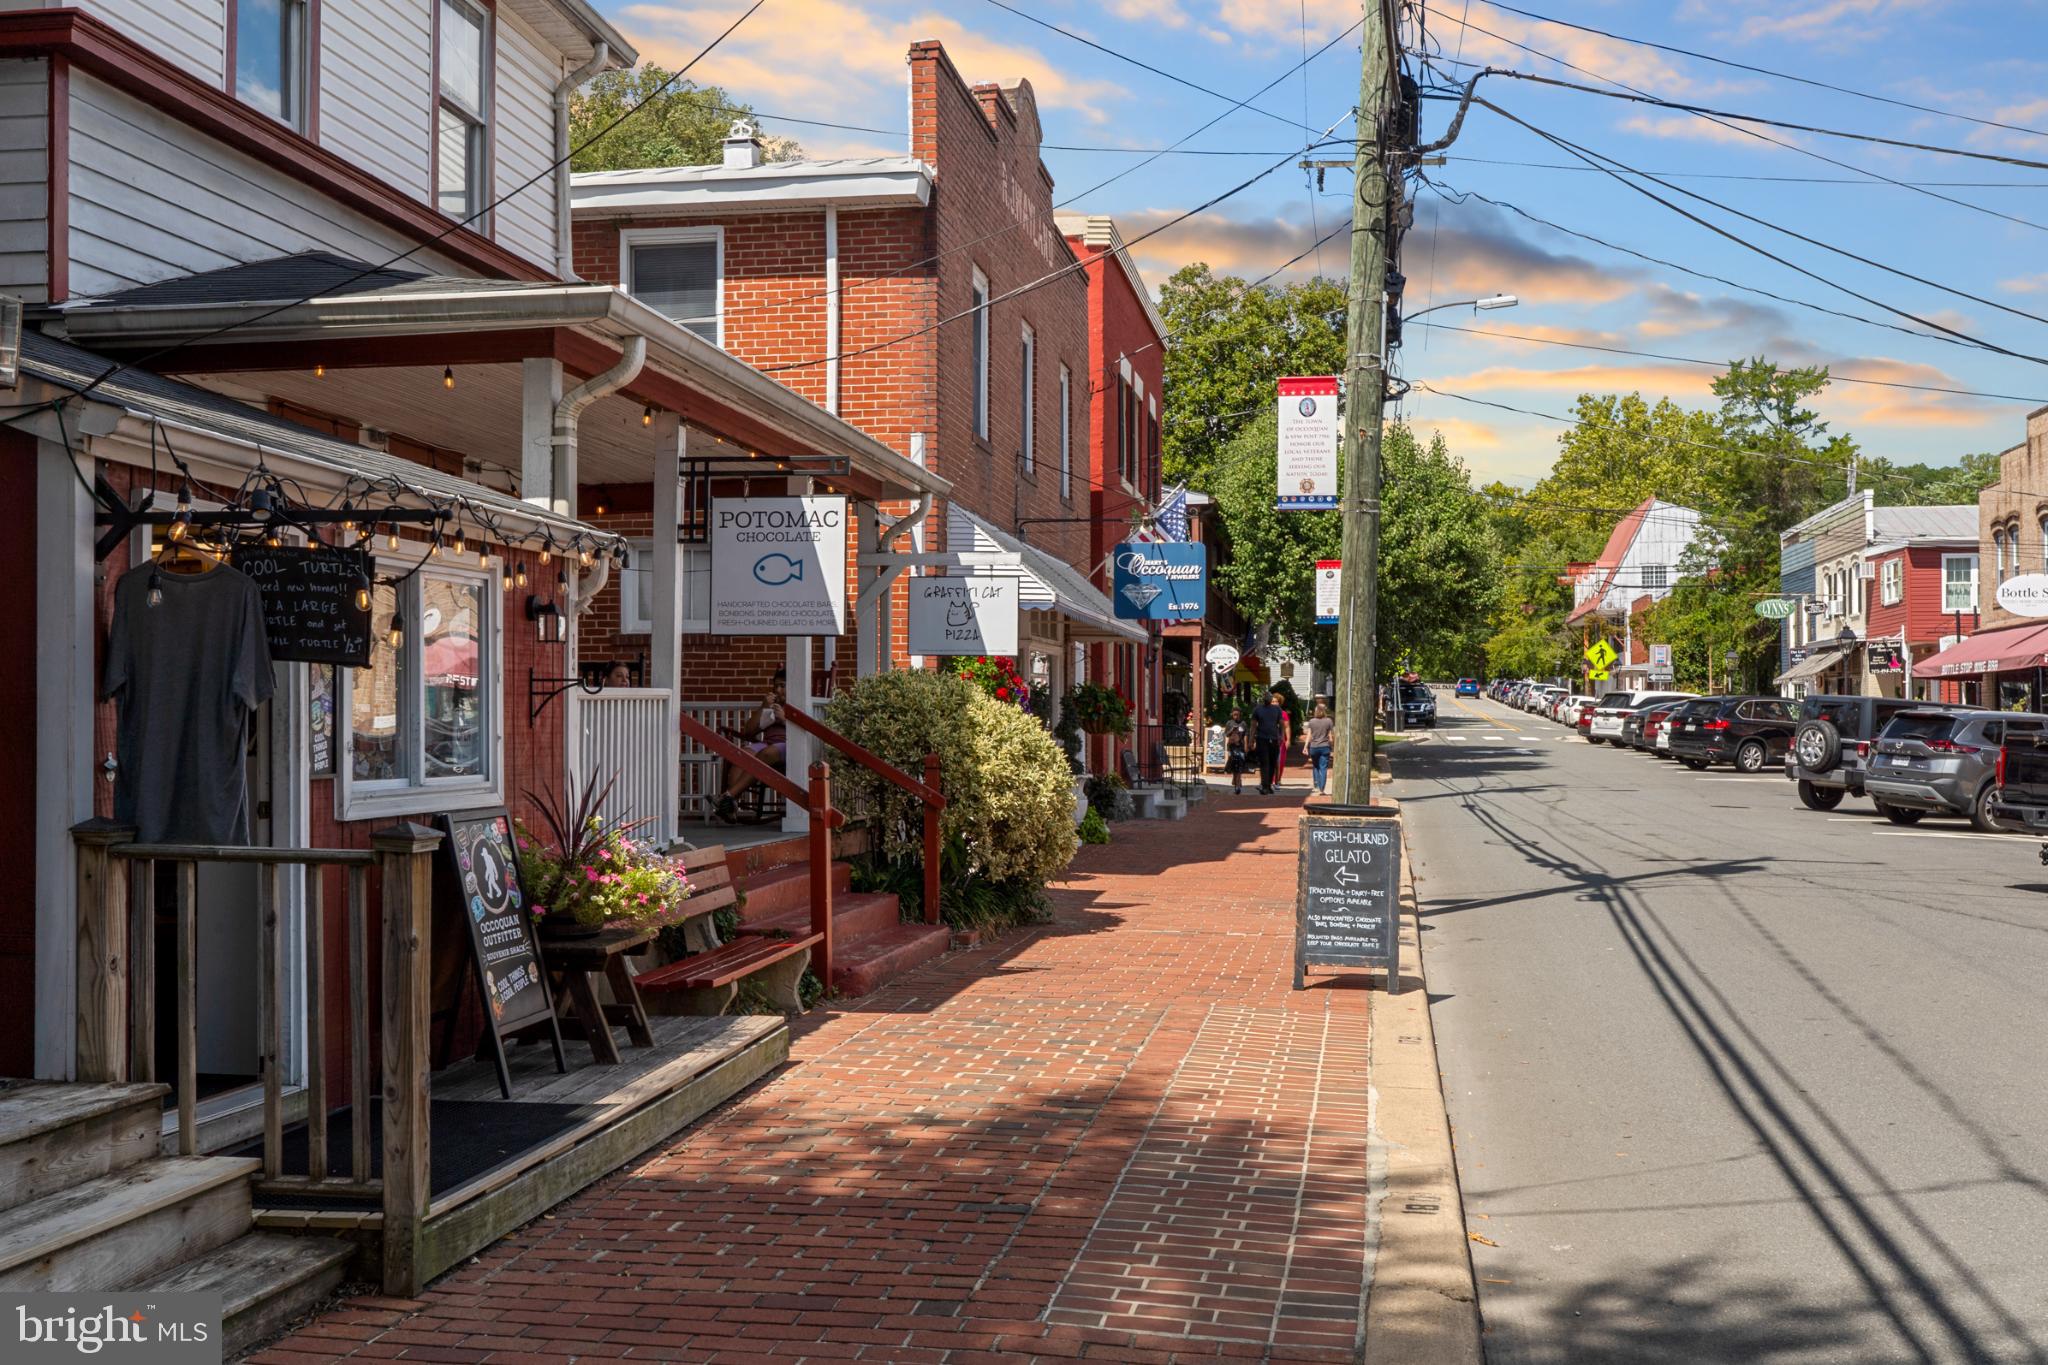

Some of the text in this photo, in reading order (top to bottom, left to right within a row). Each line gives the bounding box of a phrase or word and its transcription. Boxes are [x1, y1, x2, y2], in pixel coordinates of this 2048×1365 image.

[719, 510, 839, 528] POTOMAC
[737, 532, 820, 542] CHOCOLATE
[242, 559, 287, 577] COOL
[1117, 552, 1202, 580] Occoquan
[287, 584, 304, 592] new
[924, 586, 1003, 598] GRAFFITI CAT
[2002, 588, 2038, 598] Bottle
[276, 600, 284, 611] A
[294, 600, 338, 615] LARGE
[946, 629, 980, 640] PIZZA
[300, 638, 339, 649] TURTLE
[1313, 831, 1388, 845] FRESH-CHURNED
[1325, 849, 1371, 864] GELATO
[1309, 886, 1345, 896] TRADITIONAL
[1320, 897, 1345, 905] OPTIONS
[480, 915, 520, 934] OCCOQUAN
[483, 927, 522, 947] OUTFITTER
